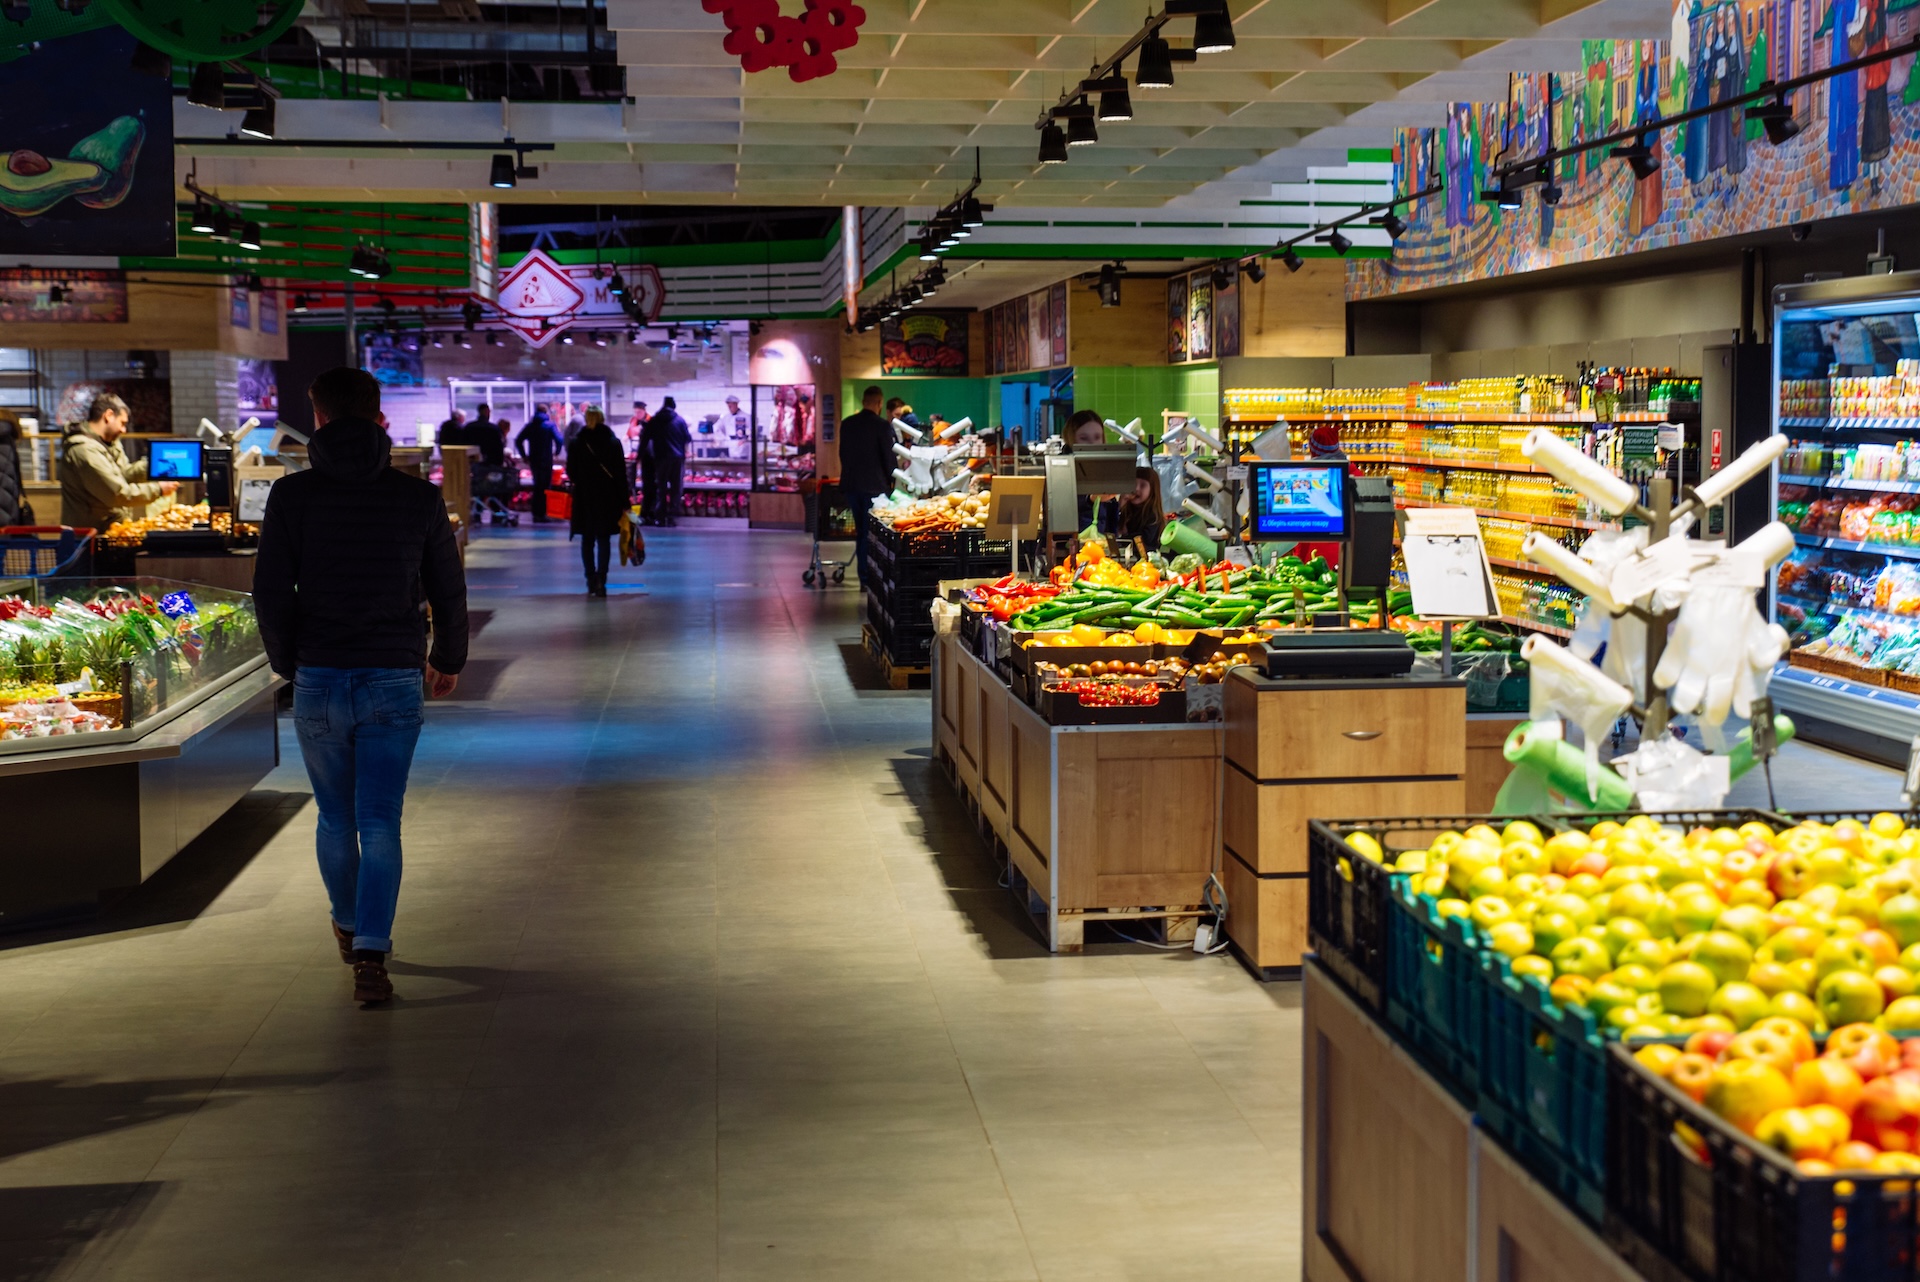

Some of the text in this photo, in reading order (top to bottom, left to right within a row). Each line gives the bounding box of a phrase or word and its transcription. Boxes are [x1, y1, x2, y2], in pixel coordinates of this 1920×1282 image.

[595, 285, 645, 303] МО
[1268, 519, 1287, 528] Оберіть
[1287, 520, 1311, 528] категорію
[1312, 520, 1329, 528] товару
